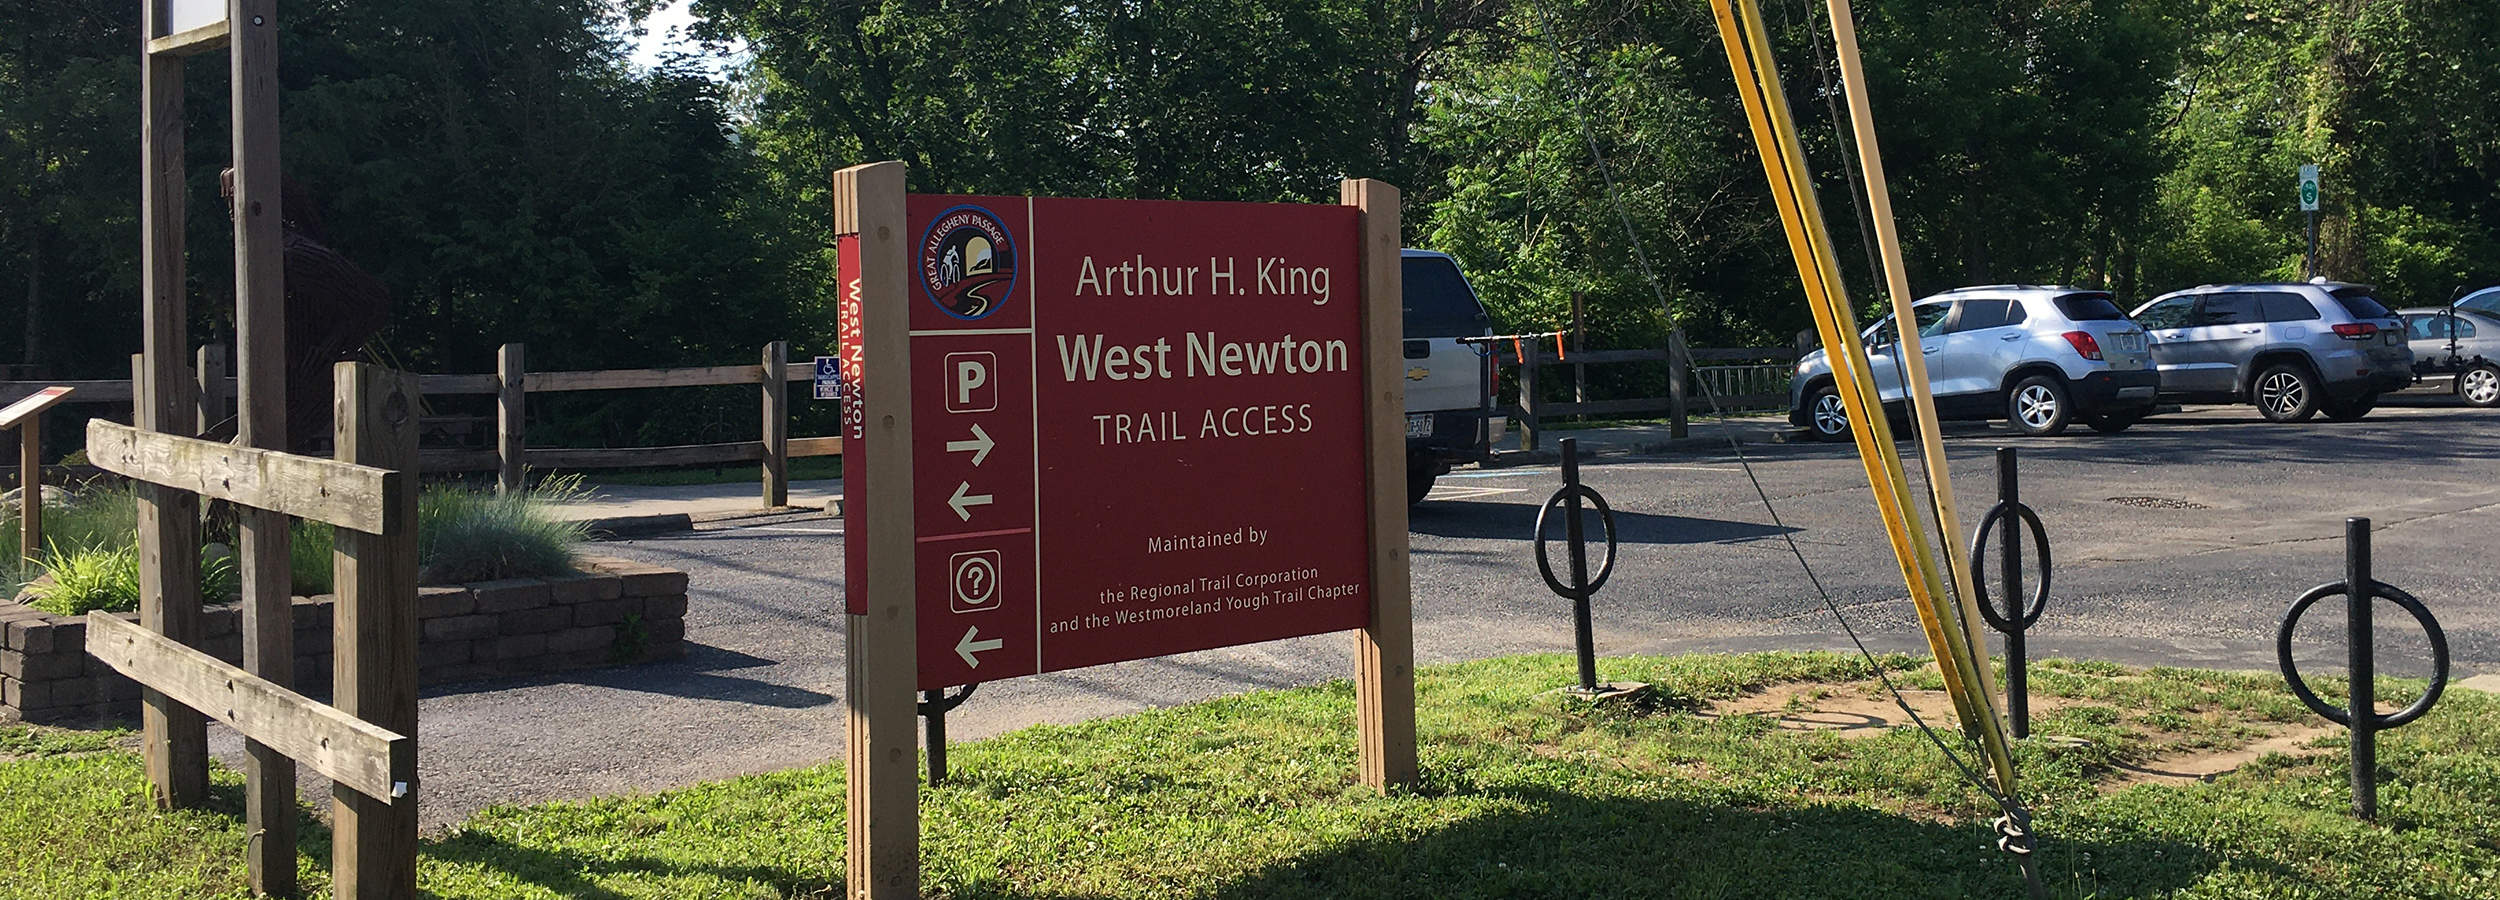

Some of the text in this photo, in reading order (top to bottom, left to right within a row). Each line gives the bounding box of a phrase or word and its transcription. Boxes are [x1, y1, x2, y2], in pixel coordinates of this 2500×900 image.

[926, 214, 1005, 291] GREAT ALLEGHENY PASSAGE
[1075, 254, 1330, 306] Arthur H. King
[840, 298, 852, 425] TRAIL ACCESS
[848, 278, 864, 440] West Newton
[1056, 331, 1349, 382] West Newton
[958, 361, 986, 404] P
[1093, 403, 1313, 446] TRAIL ACCESS
[1148, 526, 1268, 554] Maintained by
[1050, 583, 1360, 633] and the Westmoreland Yough Trail Chapter
[1100, 567, 1318, 605] the Regional Trail Corporation
